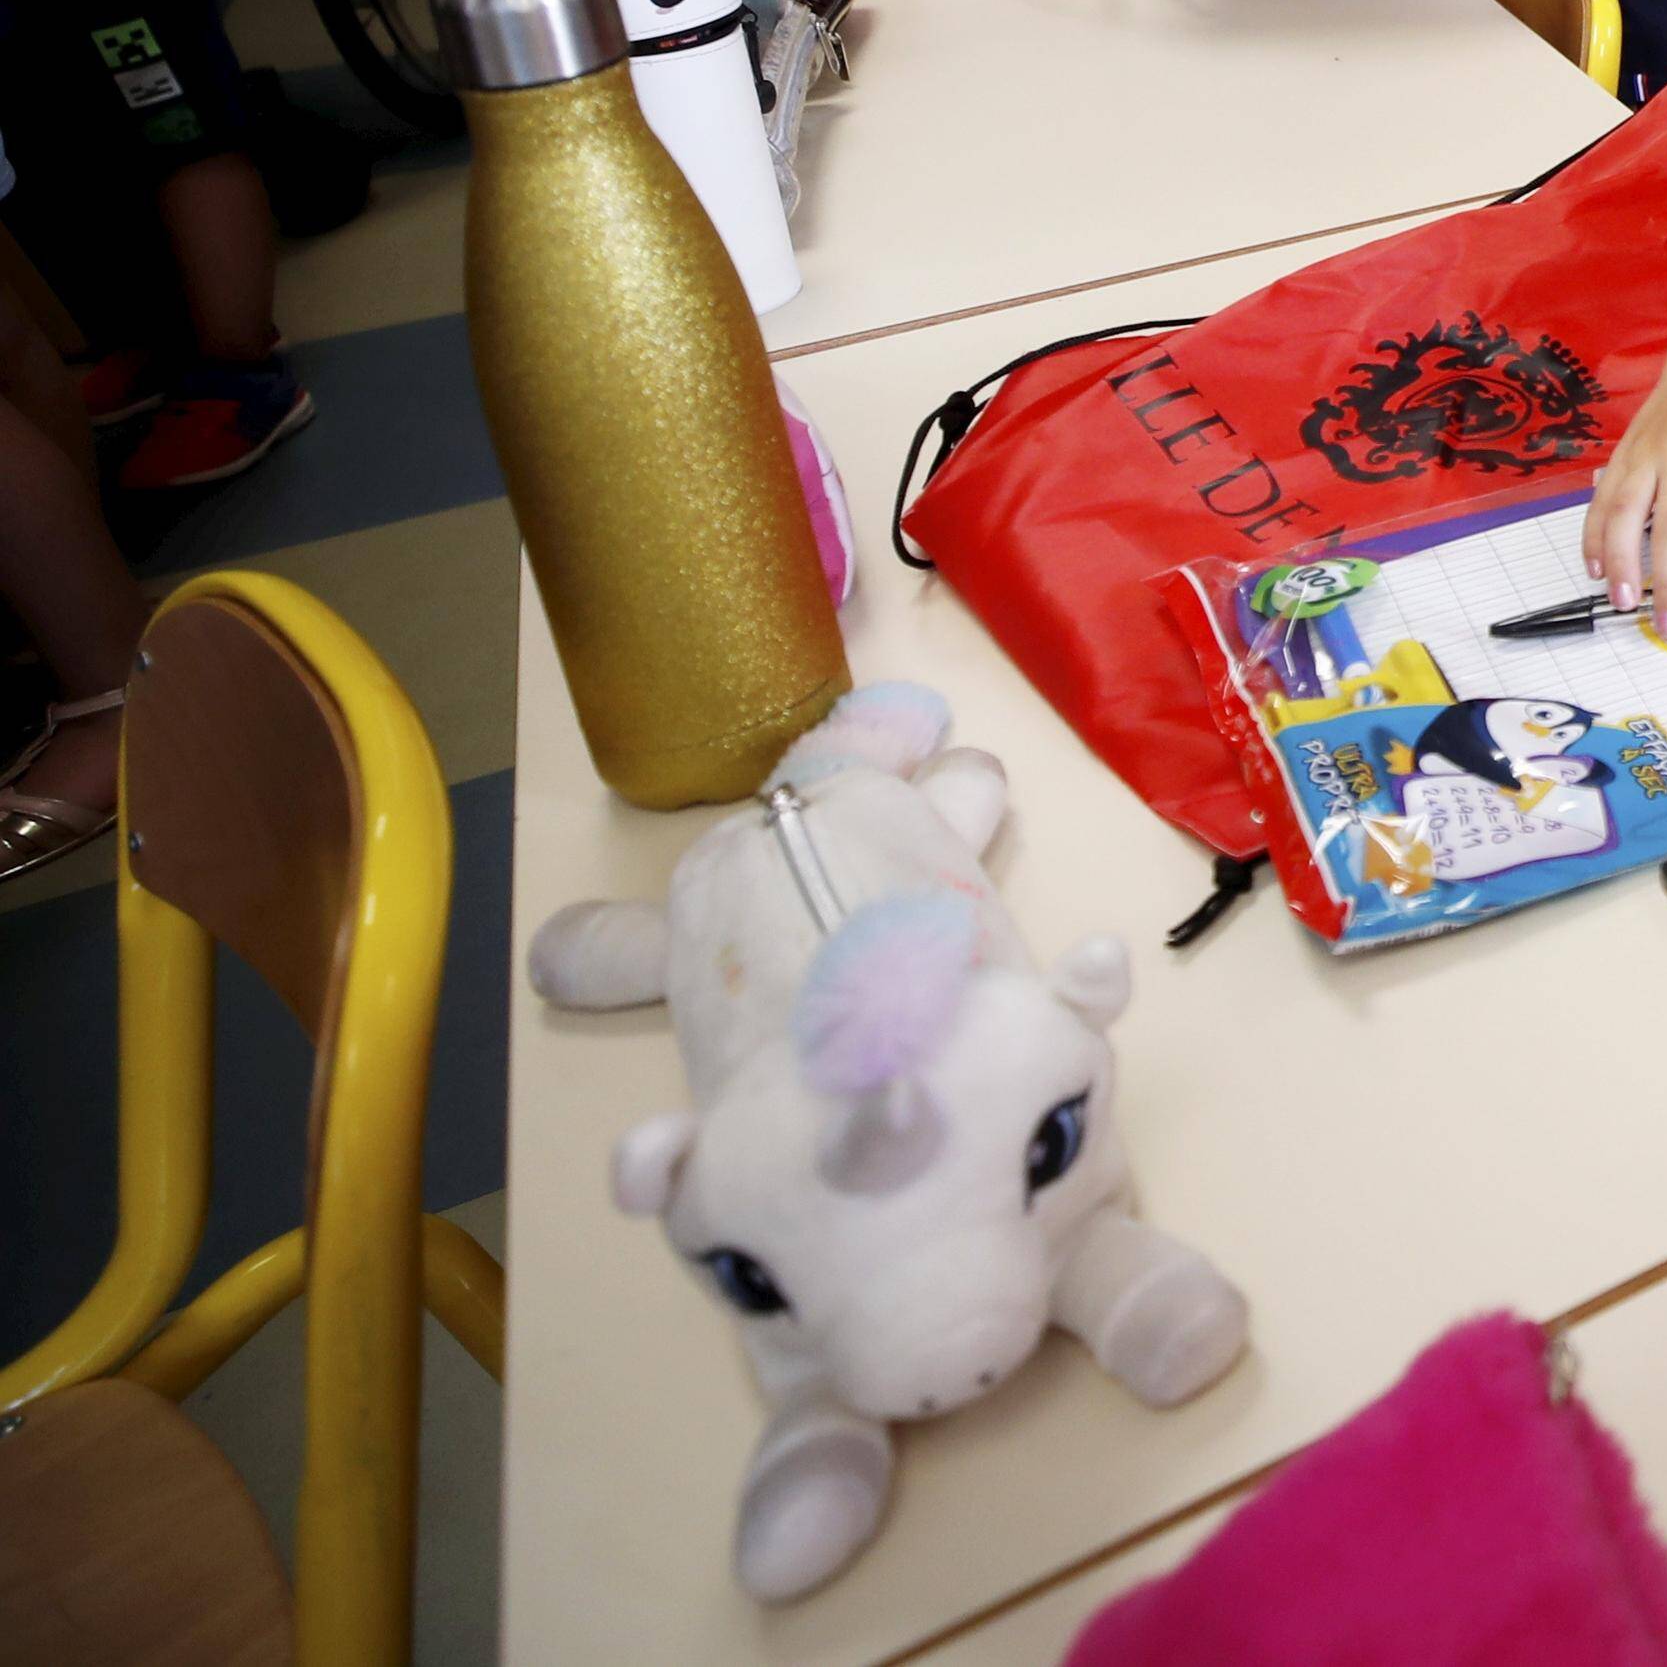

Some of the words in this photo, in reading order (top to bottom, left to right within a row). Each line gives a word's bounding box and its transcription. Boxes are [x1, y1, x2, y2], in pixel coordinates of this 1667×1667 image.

[1105, 348, 1237, 465] LLE
[1193, 453, 1320, 543] DE
[1332, 742, 1380, 801] ULTRA
